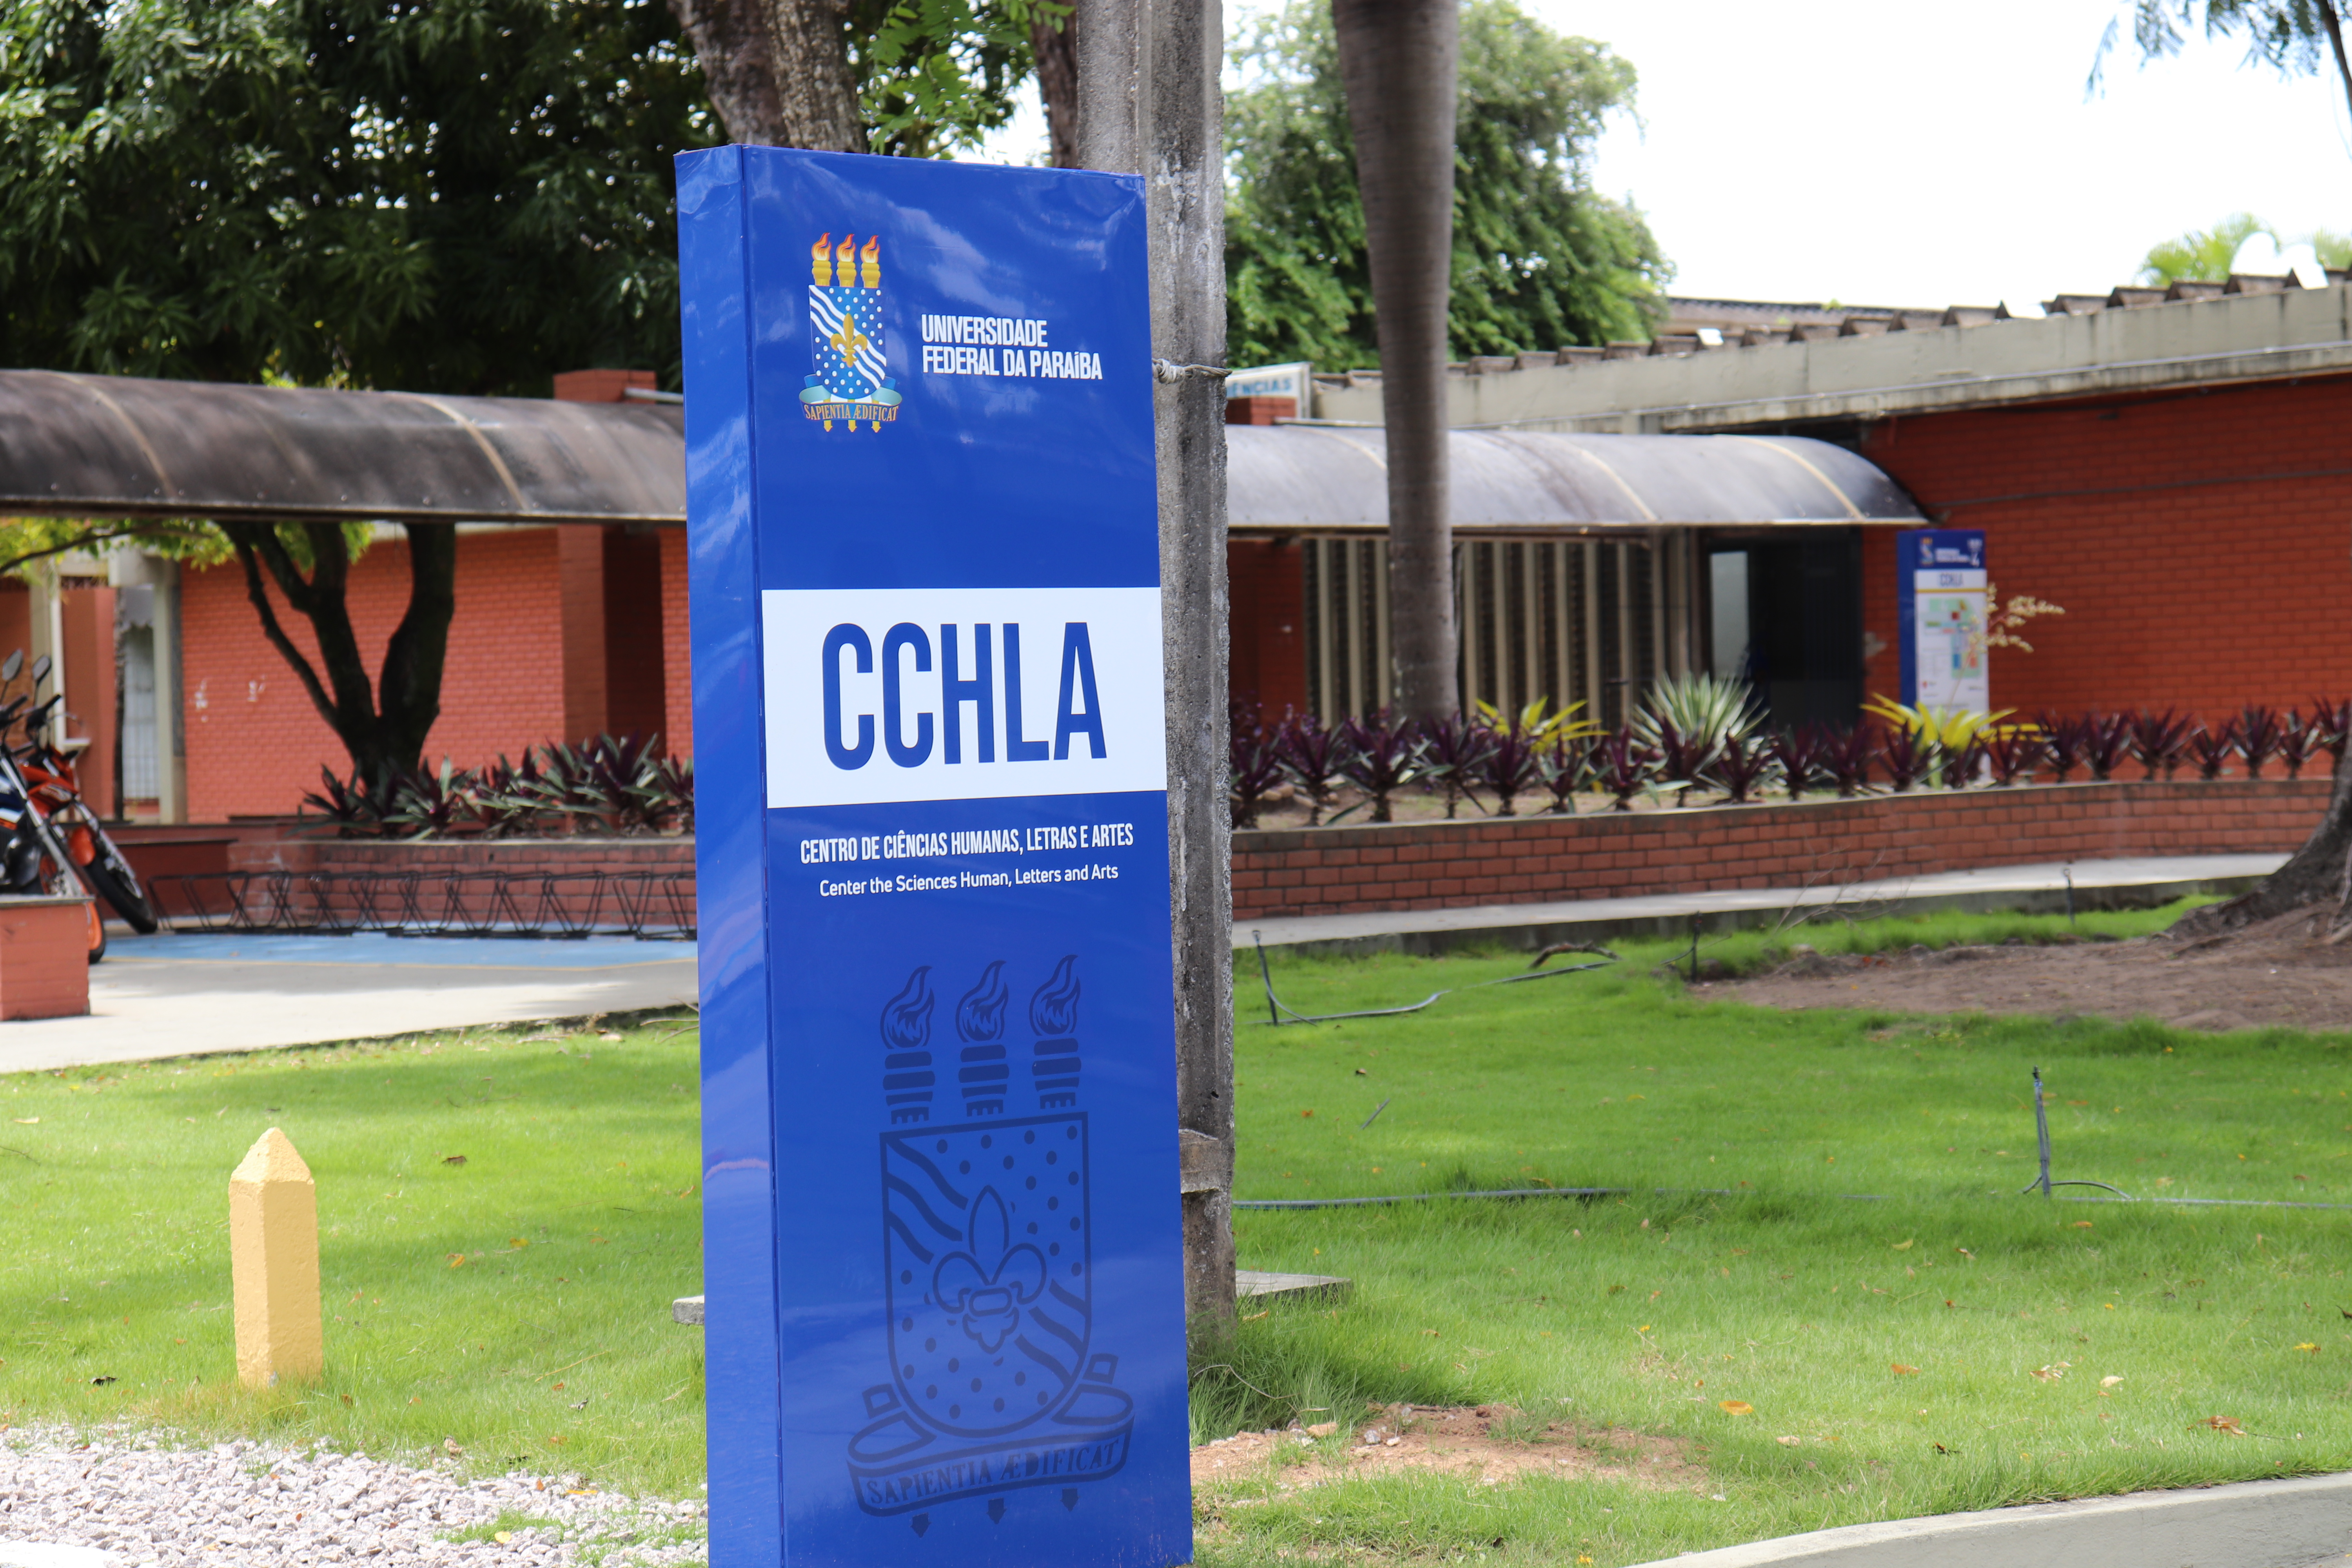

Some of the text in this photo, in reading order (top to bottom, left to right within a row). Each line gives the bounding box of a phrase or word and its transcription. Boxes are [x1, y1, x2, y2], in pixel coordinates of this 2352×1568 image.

[922, 314, 1048, 348] UNIVERSIDADE
[922, 345, 1103, 380] FEDERAL DA PARAÍBA
[804, 404, 899, 421] SAPIENTIA ÆDIFICAT
[822, 622, 1107, 770] CCHLA
[800, 823, 1133, 864] CENTRO DE CIÊNCIAS HUMANAS, LETRAS E ARTES
[820, 864, 1118, 897] Center the Sciences Human, Letters and Arts
[867, 1438, 1119, 1504] SAPIENTIA ÆDIFICAT
